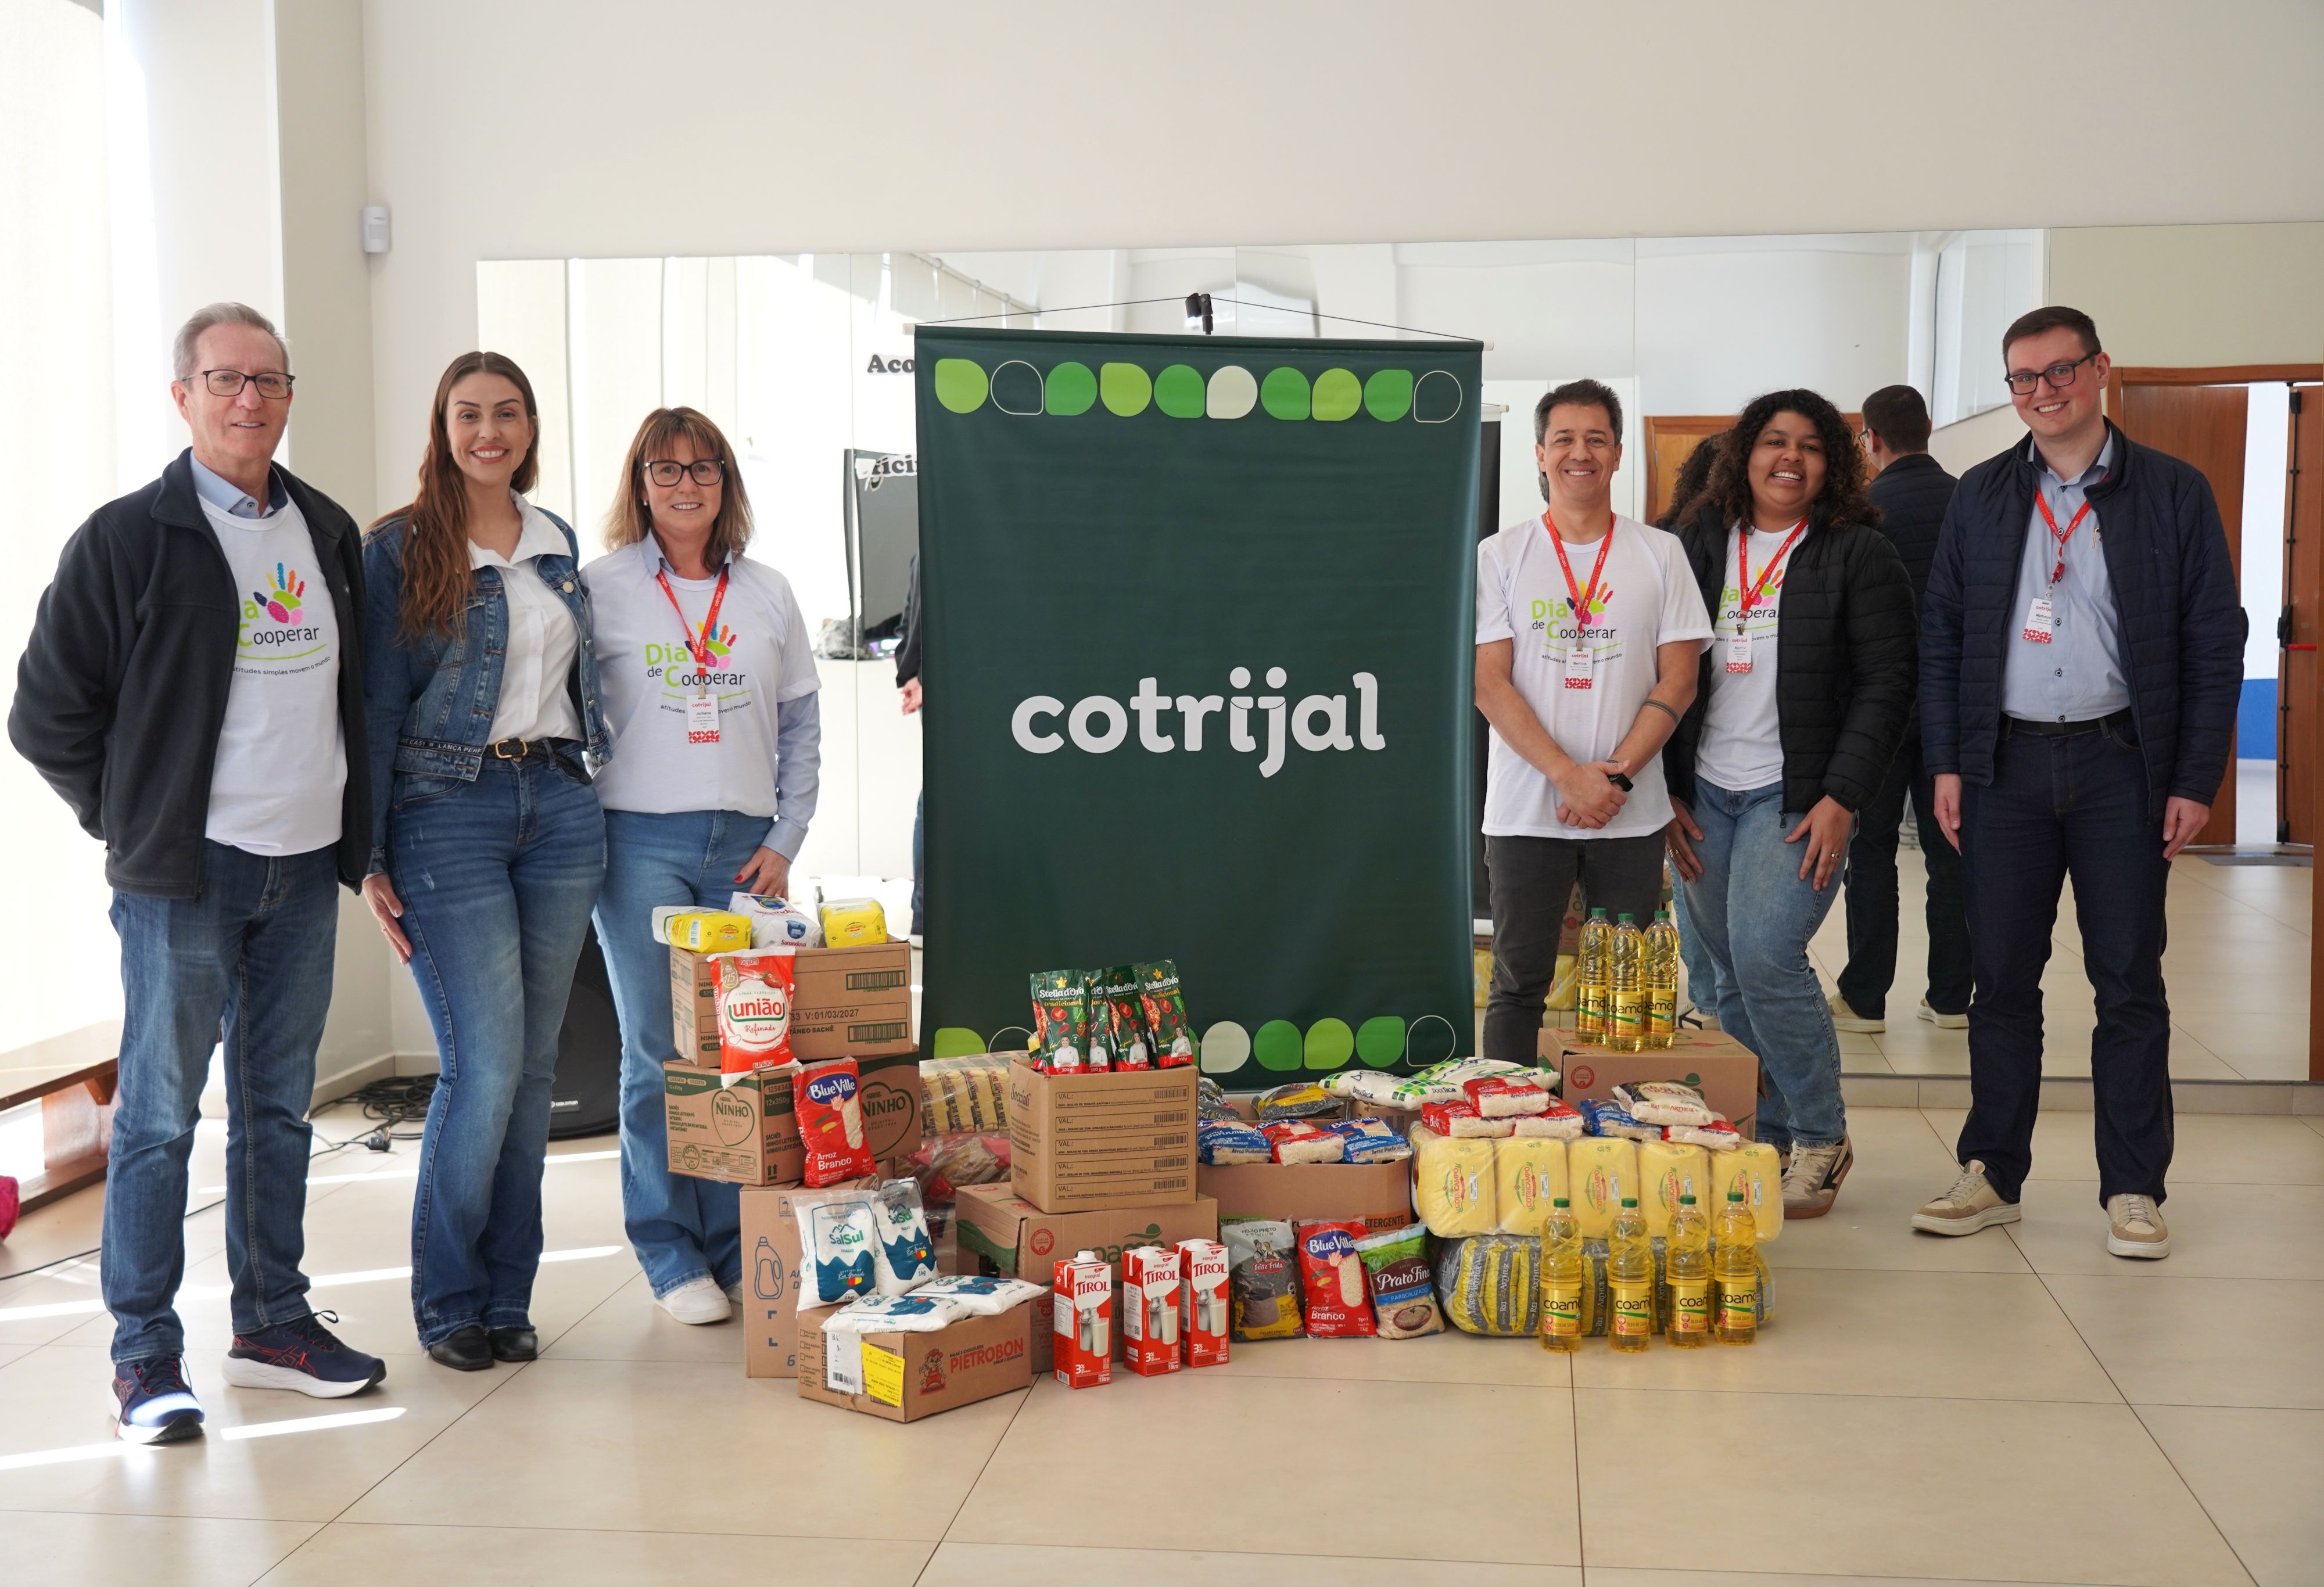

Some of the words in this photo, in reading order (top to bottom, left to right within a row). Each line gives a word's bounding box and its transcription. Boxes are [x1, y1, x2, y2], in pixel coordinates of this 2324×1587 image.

[1722, 585, 1739, 603] ia
[1532, 598, 1568, 619] Dia
[1717, 604, 1779, 621] Coopera
[1532, 620, 1545, 630] de
[645, 642, 689, 666] Dia
[1541, 655, 1561, 663] atitudes
[1605, 652, 1622, 661] mundo
[289, 666, 310, 674] movem
[315, 656, 331, 668] mundo
[647, 666, 662, 677] de
[661, 704, 686, 713] atitudes
[734, 701, 751, 712] mundo
[1012, 667, 1386, 778] cotrijal
[1039, 989, 1063, 998] Stella
[733, 998, 783, 1017] união
[812, 1025, 834, 1033] SACHÊ
[755, 1060, 773, 1068] união
[766, 1097, 790, 1106] 12x350g
[1669, 1105, 1695, 1113] ARTHUR
[716, 1101, 749, 1118] NINHO
[817, 1152, 837, 1161] Arroz
[818, 1157, 852, 1170] Branco
[1524, 1166, 1532, 1208] COTRICAMPO
[1594, 1169, 1602, 1211] COTRICAMPO
[1667, 1171, 1676, 1212] COTRICAMPO
[888, 1208, 913, 1225] SalSul
[1365, 1215, 1404, 1228] ETERGENTE
[829, 1230, 865, 1245] SalSul
[1144, 1270, 1178, 1285] TIROL
[1193, 1263, 1228, 1277] TIROL
[1500, 1263, 1510, 1291] ARTHUR
[1532, 1262, 1540, 1291] ARTHUR
[1377, 1273, 1411, 1290] Prato
[1410, 1266, 1430, 1282] Fino
[1075, 1281, 1110, 1296] TIROL
[1390, 1287, 1429, 1301] PARBOILIZADO
[1598, 1280, 1606, 1307] ARTHUR
[1616, 1298, 1651, 1310] coam
[1311, 1310, 1346, 1320] Branco
[787, 1355, 795, 1366] 6
[950, 1337, 1024, 1374] PIETROBON
